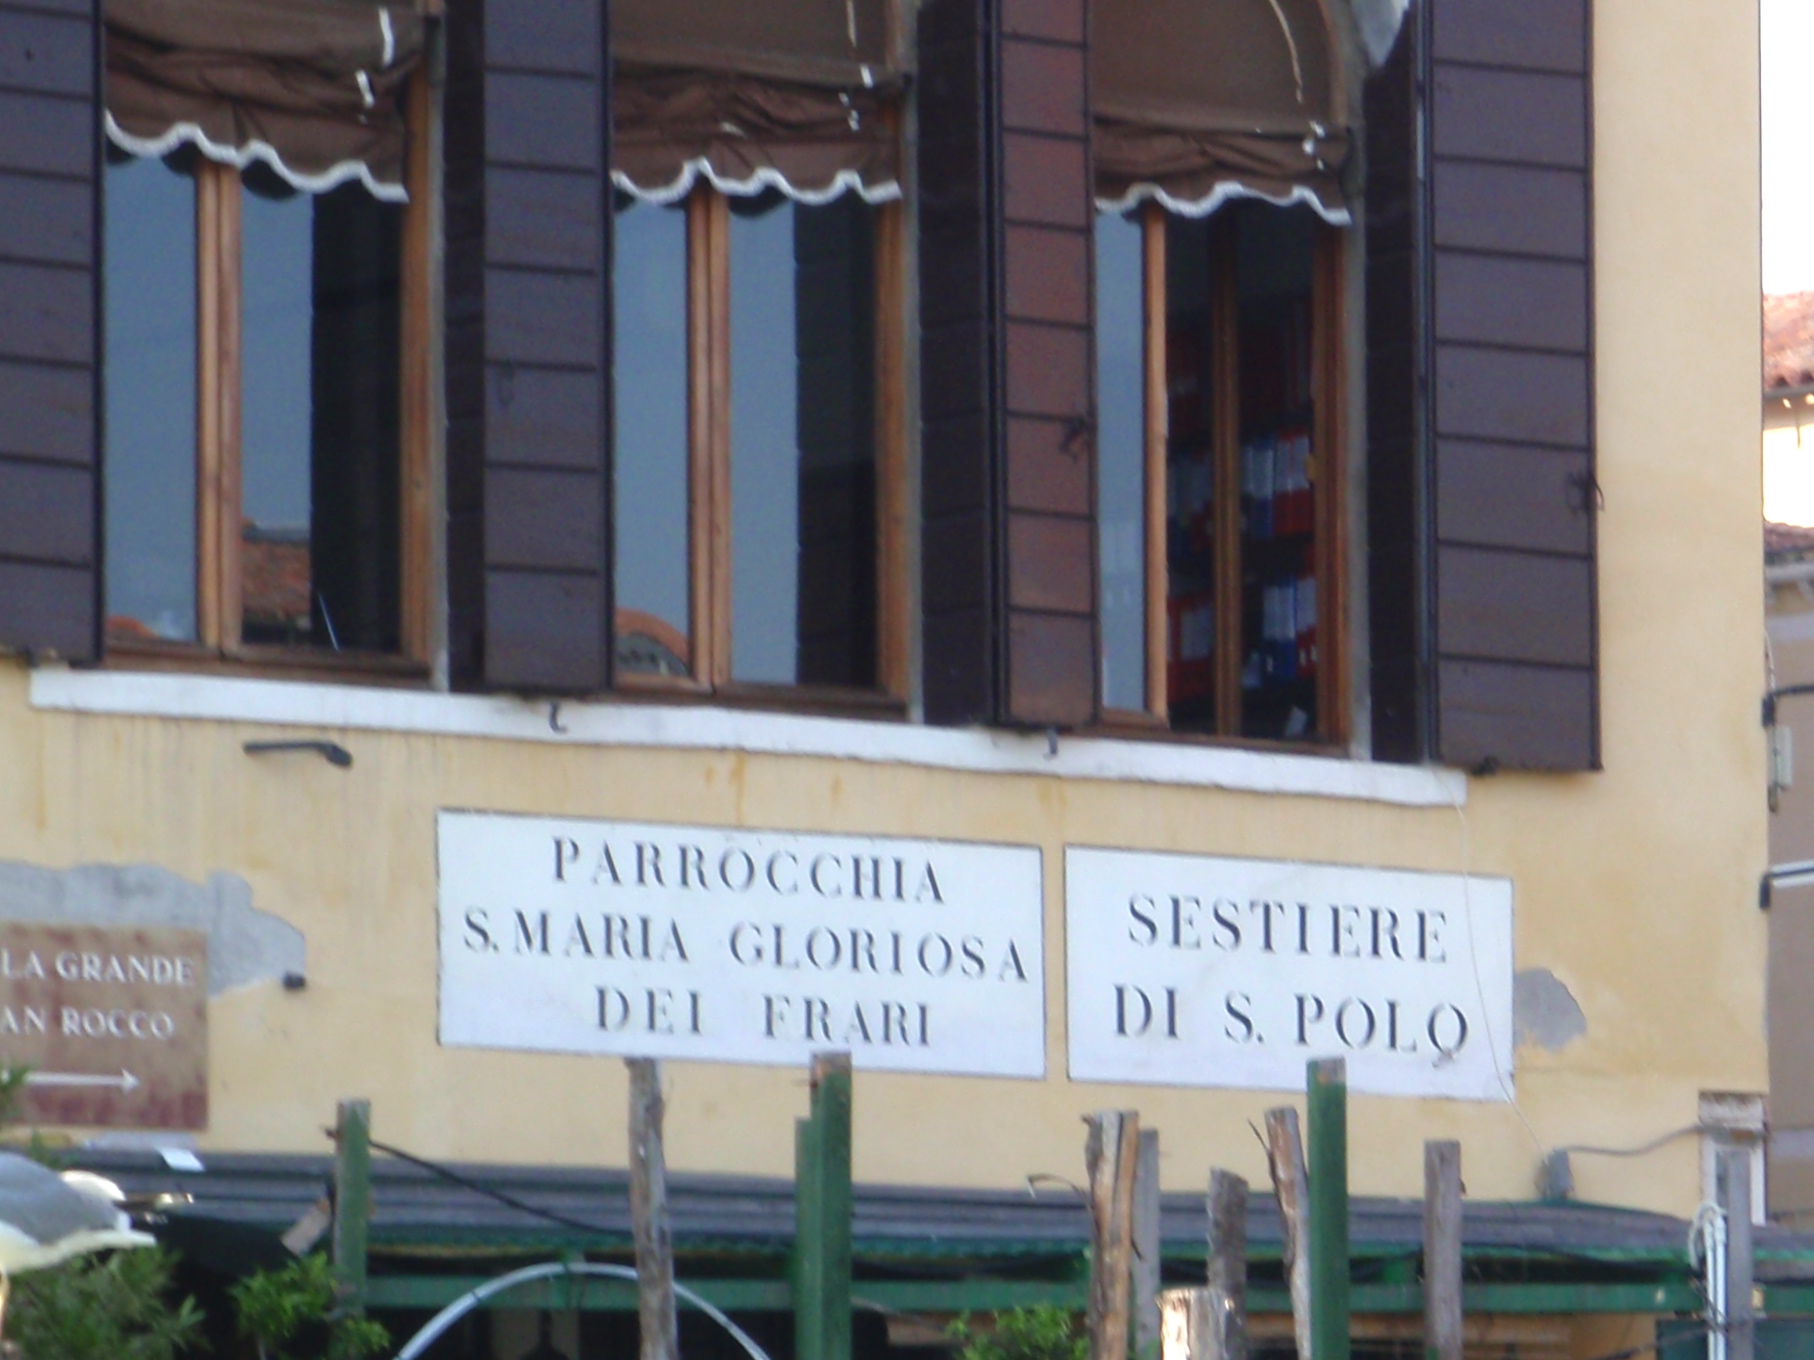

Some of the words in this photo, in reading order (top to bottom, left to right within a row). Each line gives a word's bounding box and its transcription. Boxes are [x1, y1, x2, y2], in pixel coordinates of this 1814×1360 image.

[551, 836, 946, 904] PARROCCHIA
[728, 920, 1028, 982] GLORIOSA
[1128, 893, 1448, 963] SESTIERE
[54, 951, 195, 986] GRANDE
[61, 1006, 175, 1040] ROCCO
[596, 986, 703, 1036] DEI
[764, 995, 931, 1047] FRARI
[1113, 983, 1181, 1041] DI
[1294, 992, 1469, 1056] POLO
